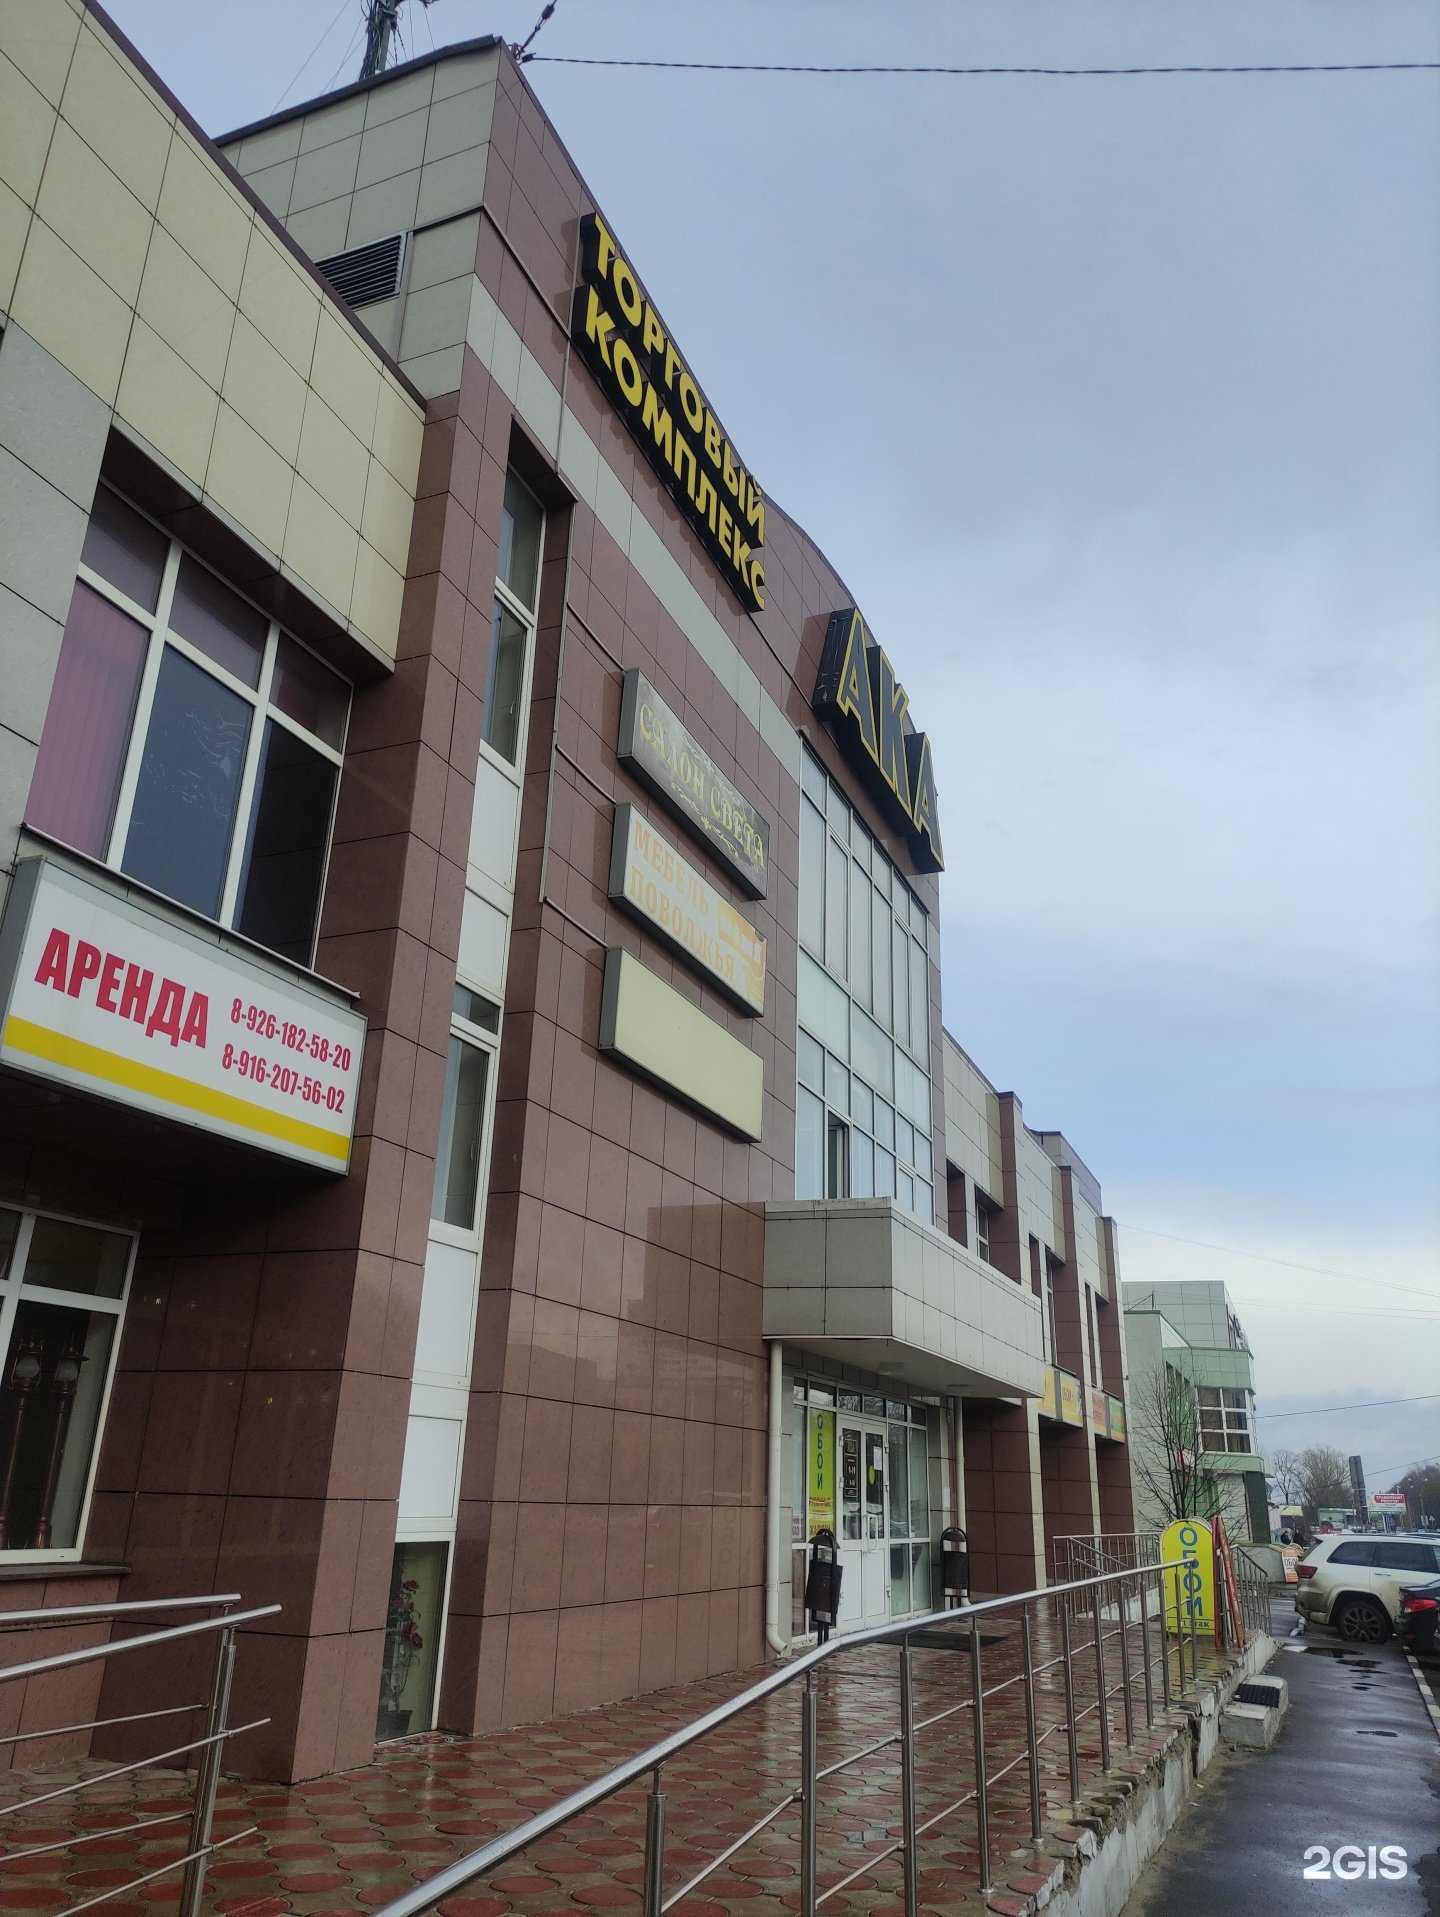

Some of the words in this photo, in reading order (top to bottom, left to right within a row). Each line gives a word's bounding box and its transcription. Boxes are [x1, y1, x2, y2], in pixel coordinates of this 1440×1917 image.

[594, 213, 765, 544] ТОРГОВЫЙ
[585, 285, 765, 610] КОМПЛЕКС
[639, 703, 705, 801] САЛОН
[710, 787, 765, 870] СВЕТА
[836, 608, 945, 872] АКА
[34, 927, 210, 1048] АРЕНДА
[230, 998, 351, 1071] 8-926-182-58-20
[222, 1044, 345, 1113] 8-916-207-56-02
[816, 1414, 824, 1490] ОБОИ
[1180, 1526, 1203, 1617] ОБОИ
